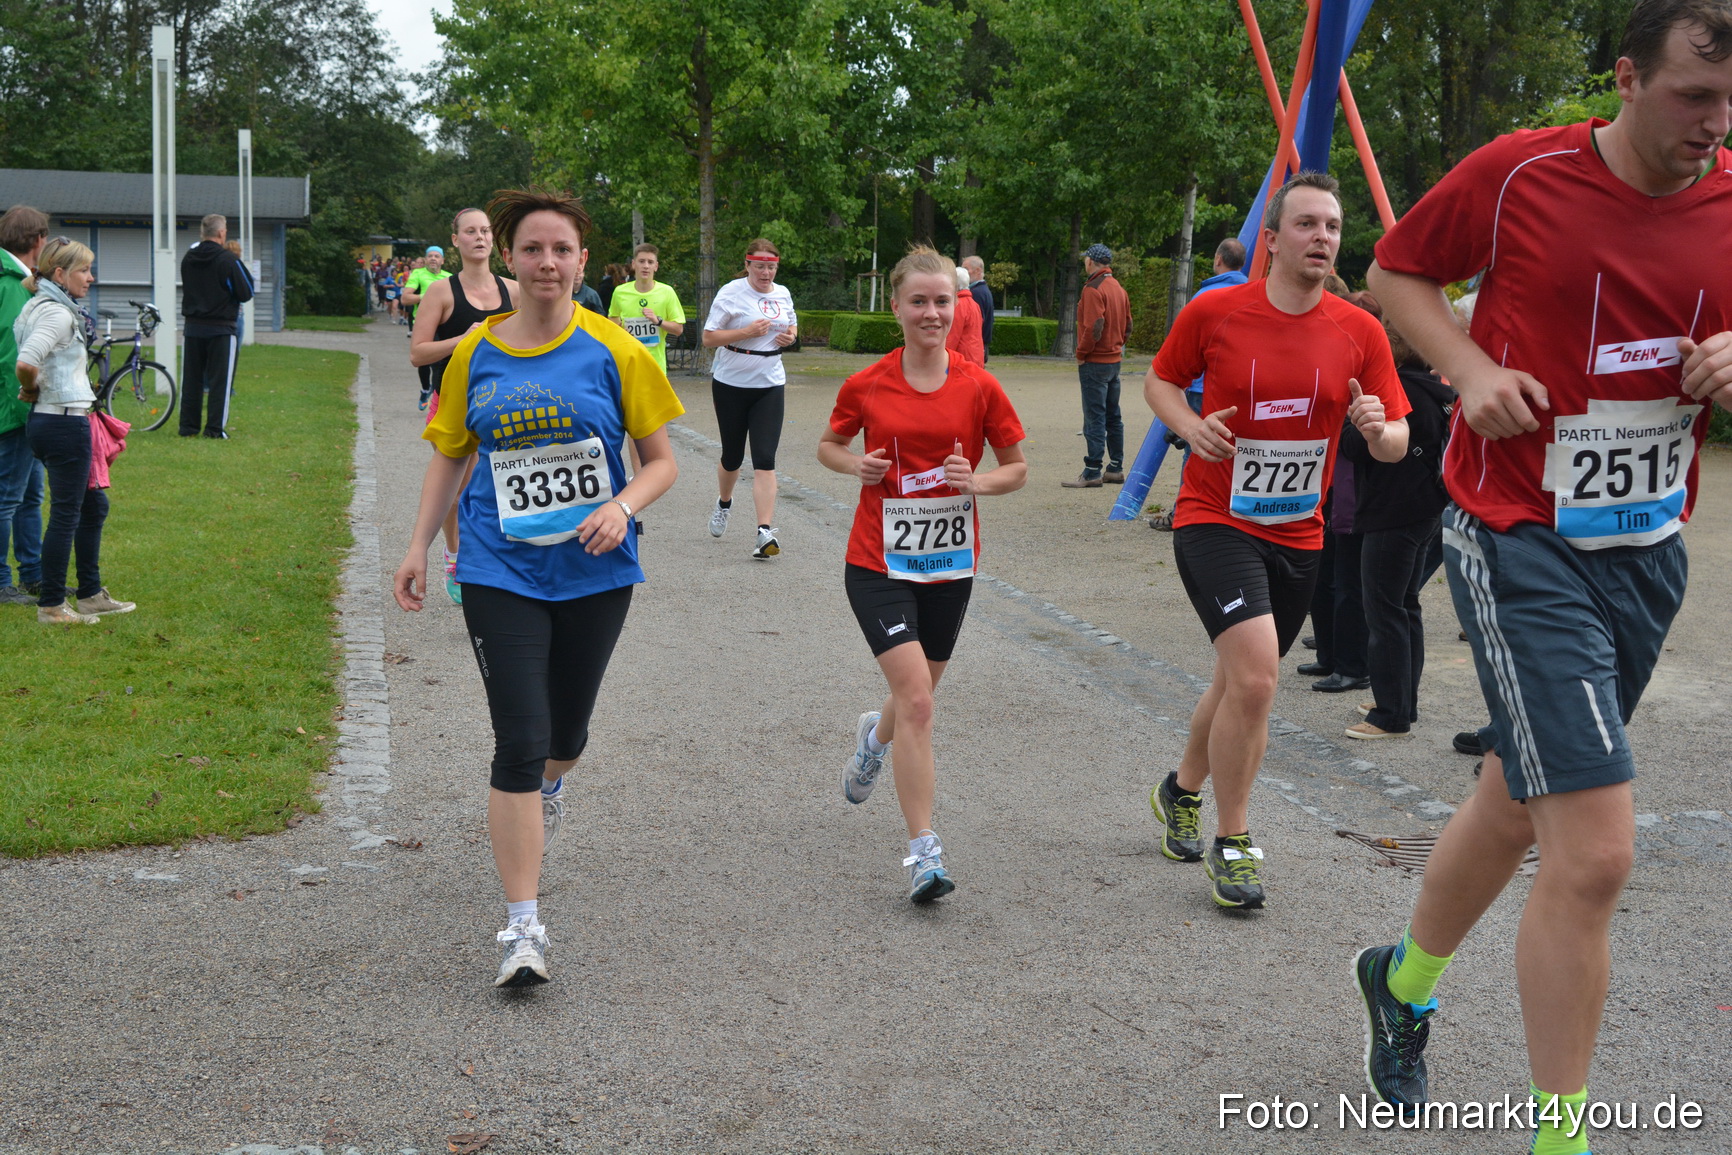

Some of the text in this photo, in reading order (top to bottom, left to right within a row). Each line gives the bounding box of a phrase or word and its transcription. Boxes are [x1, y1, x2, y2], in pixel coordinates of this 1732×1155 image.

[627, 324, 656, 336] 2016
[1620, 347, 1660, 363] DEHN
[1269, 404, 1295, 414] DEHN
[553, 431, 574, 439] 2014
[1558, 422, 1679, 442] PARTL Neumarkt
[1237, 446, 1312, 458] PARTL Neumarkt
[494, 451, 585, 472] PARTL Neumarkt
[1572, 437, 1683, 500] 2515
[915, 473, 937, 486] DEHN
[1242, 460, 1318, 493] 2727
[506, 464, 600, 512] 3336
[885, 505, 960, 516] PARTL Neumarkt
[1253, 502, 1300, 513] Andreas
[1614, 510, 1650, 530] Tim
[893, 515, 967, 551] 2728
[907, 556, 953, 571] Melanie
